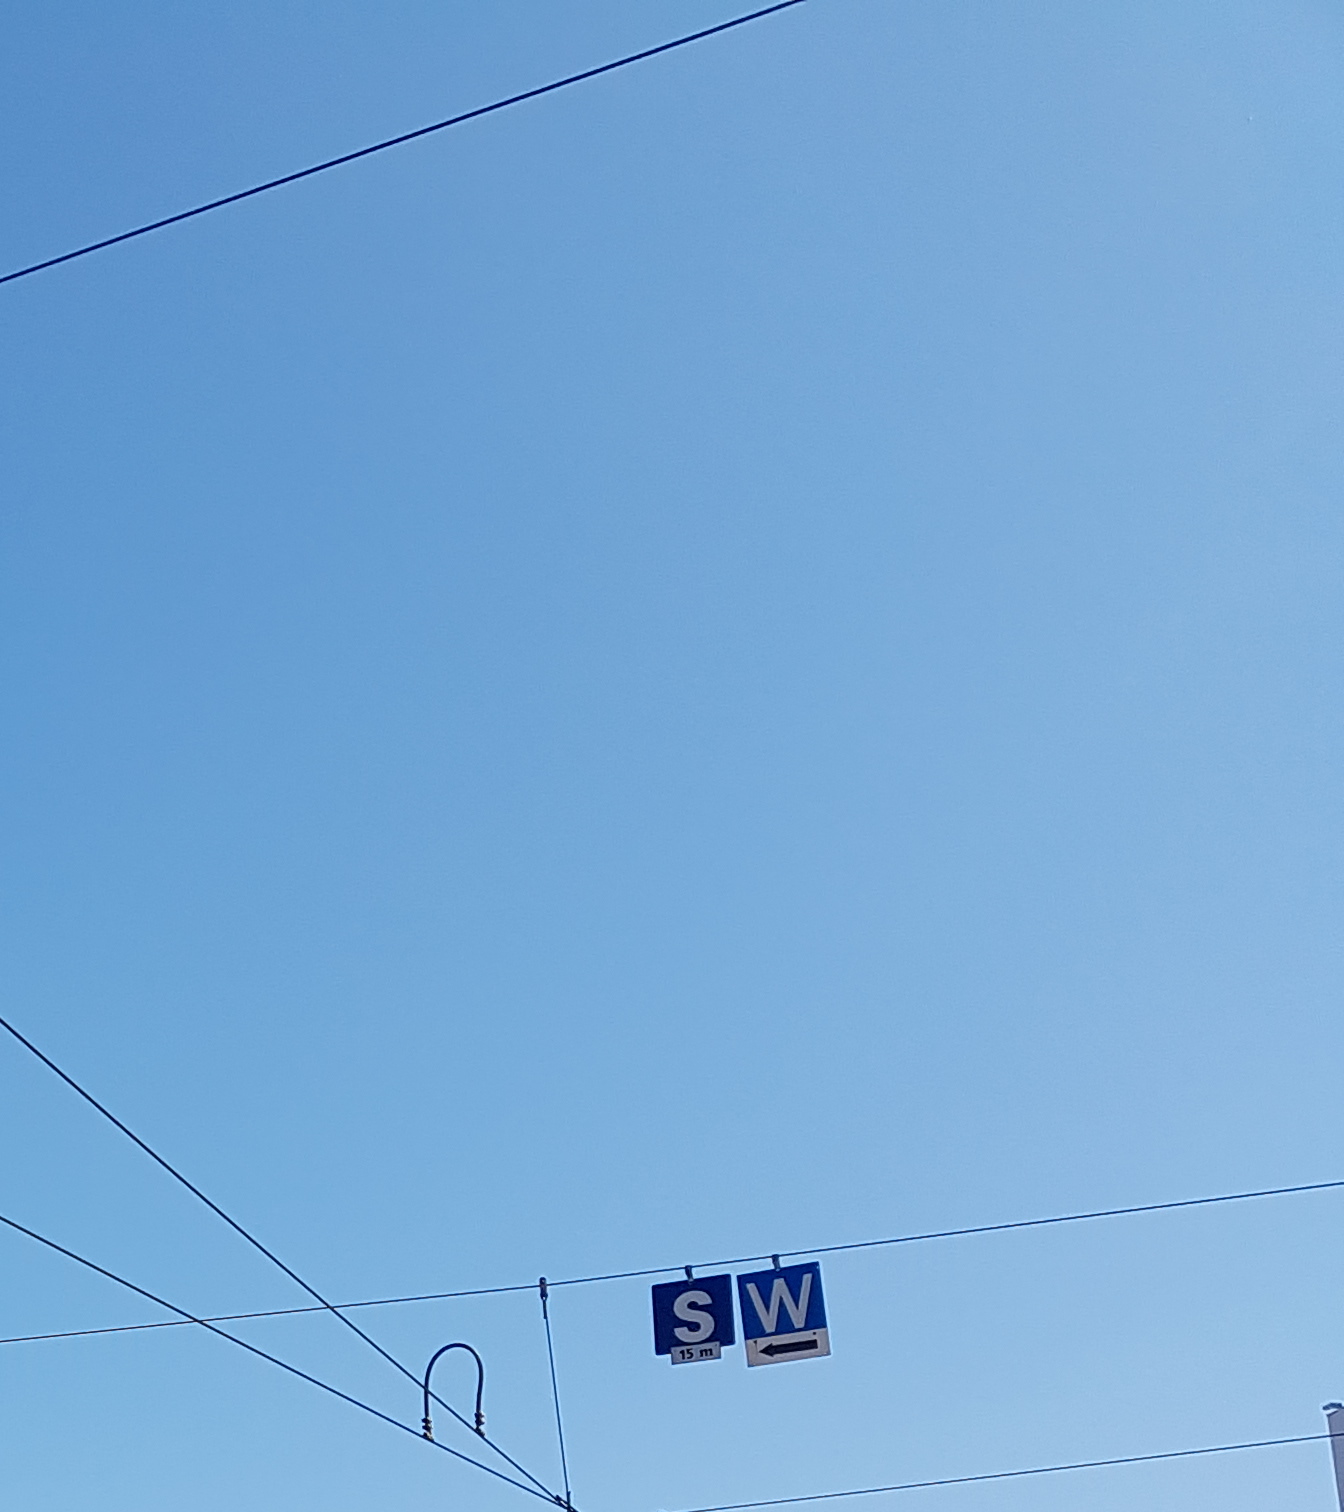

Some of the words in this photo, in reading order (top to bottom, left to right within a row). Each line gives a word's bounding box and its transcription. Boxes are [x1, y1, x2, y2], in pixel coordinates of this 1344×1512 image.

[673, 1290, 715, 1343] S
[745, 1273, 812, 1334] W
[679, 1348, 694, 1361] 15
[699, 1348, 713, 1358] m
